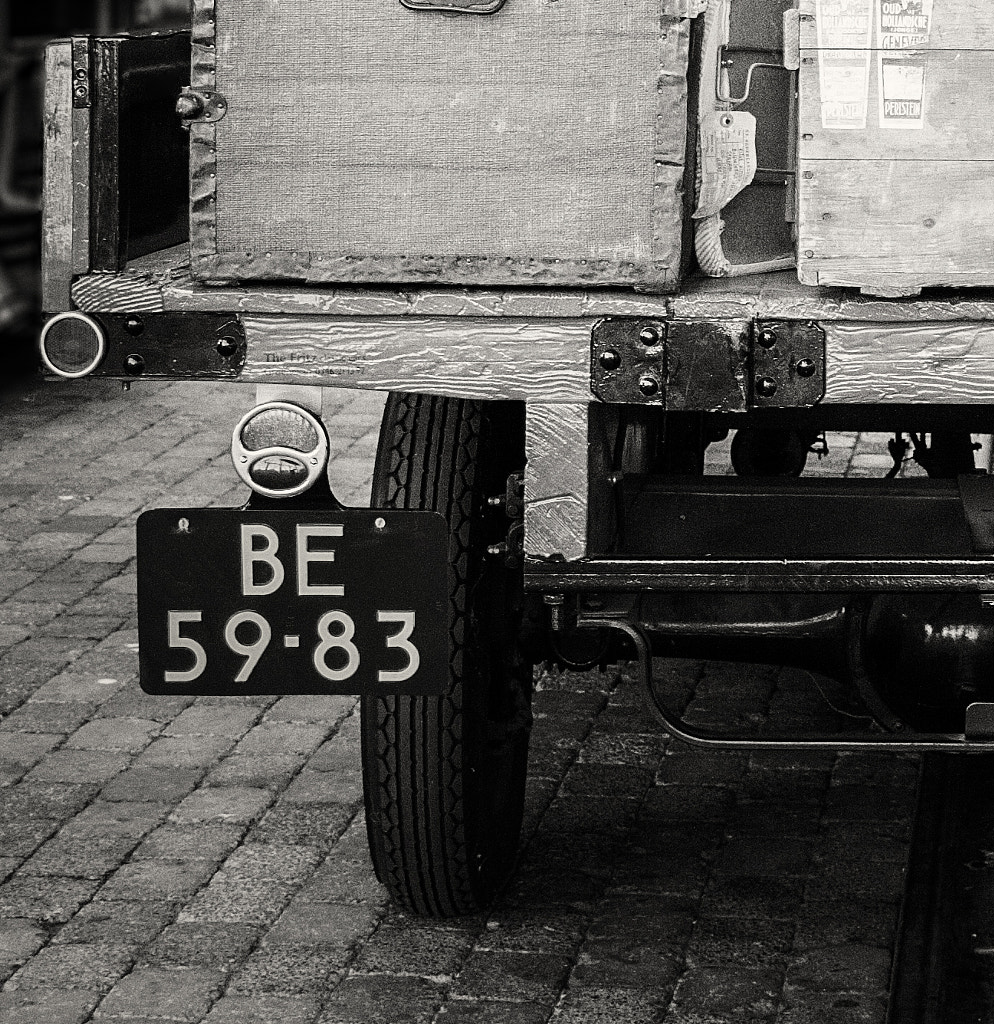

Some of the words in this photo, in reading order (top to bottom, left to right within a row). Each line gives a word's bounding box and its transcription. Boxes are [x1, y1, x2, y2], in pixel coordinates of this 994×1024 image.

[882, 3, 901, 14] OUD
[884, 102, 921, 116] PERLSTEIN
[263, 352, 287, 362] The
[290, 352, 317, 362] Fritz
[240, 523, 345, 596] BE
[163, 609, 420, 682] 59-83
